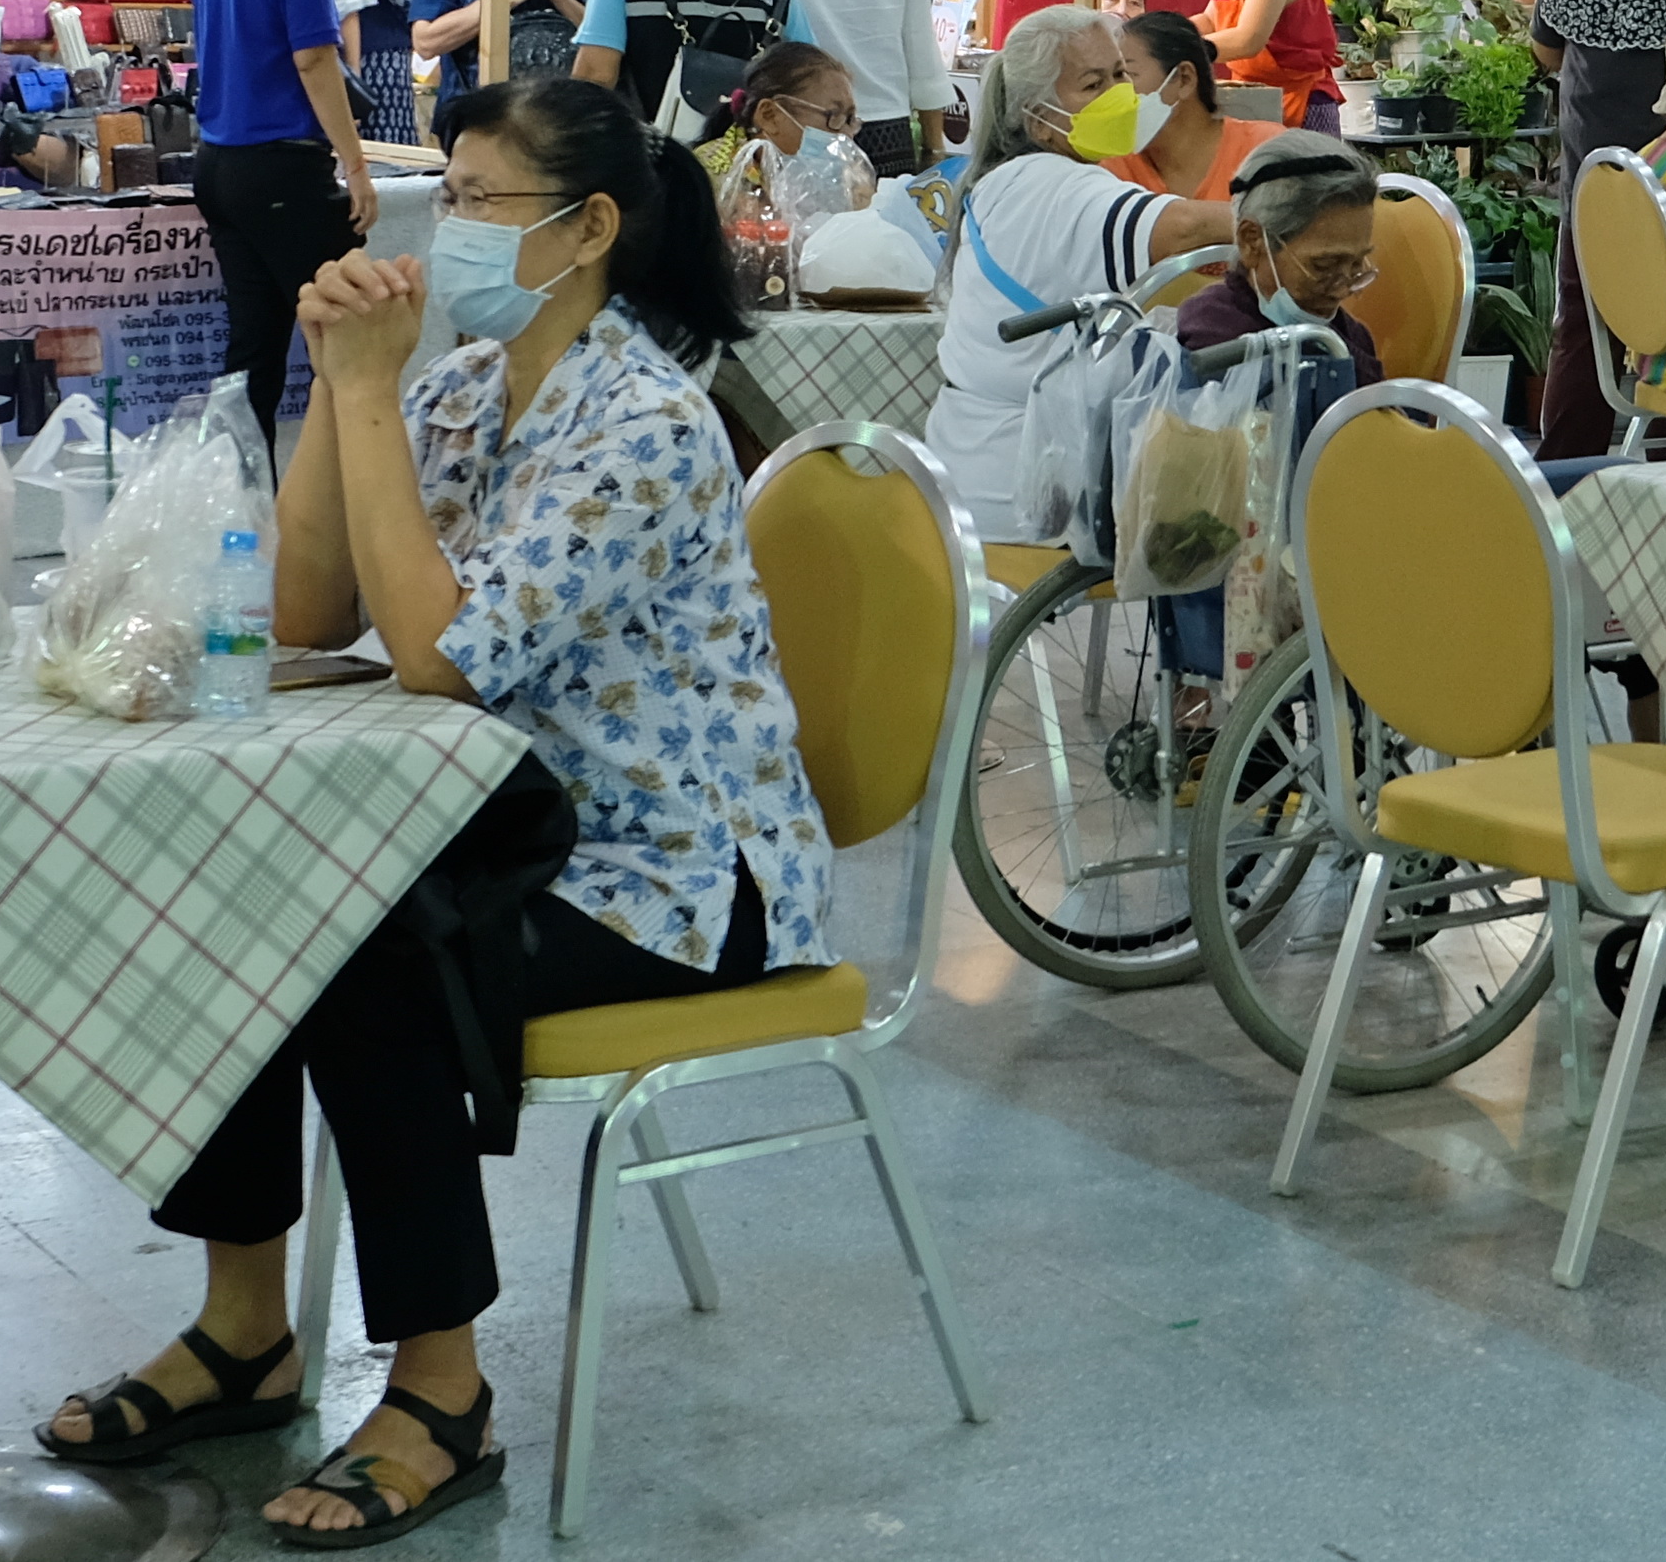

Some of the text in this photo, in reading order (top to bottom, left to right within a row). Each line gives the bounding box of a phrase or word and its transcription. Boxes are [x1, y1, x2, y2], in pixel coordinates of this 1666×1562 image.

[133, 253, 214, 285] กระเป๋า
[34, 292, 149, 317] ปลากระเบน
